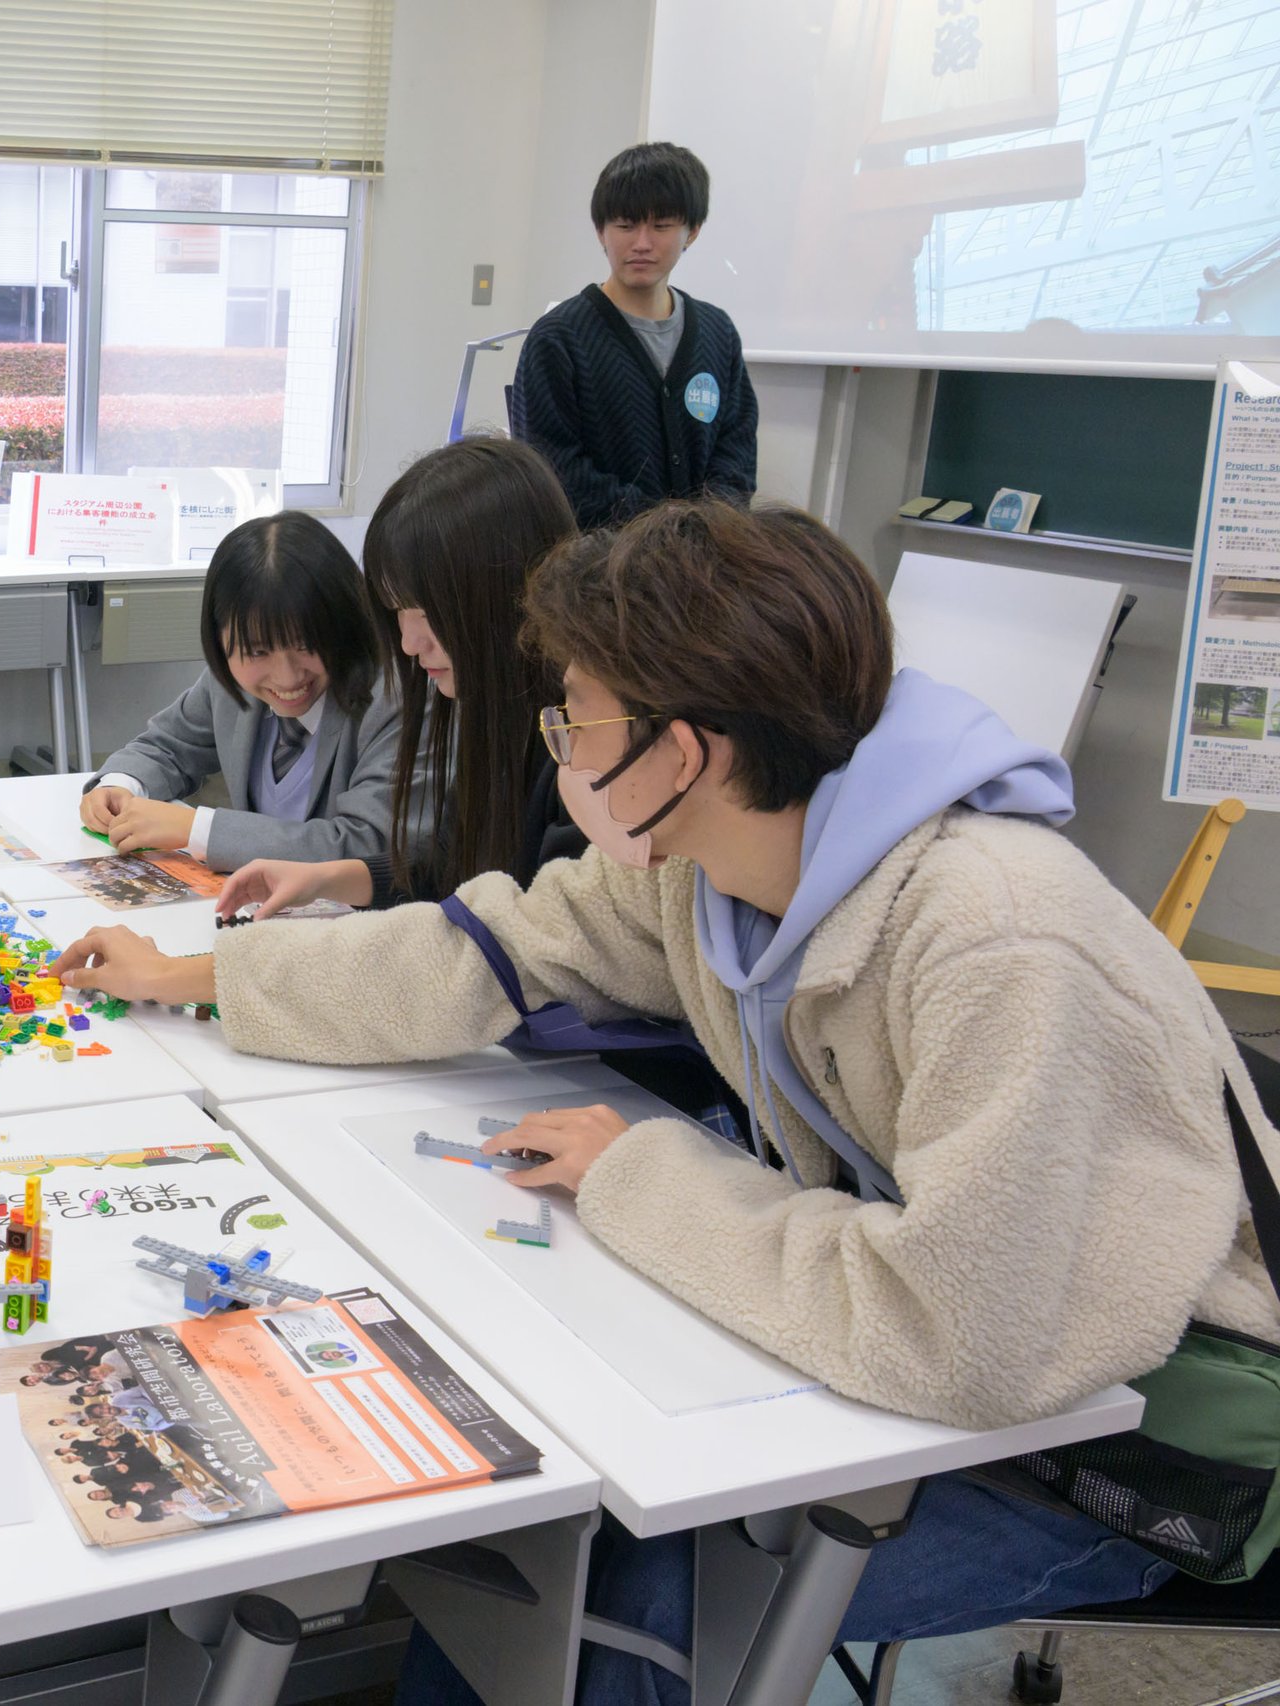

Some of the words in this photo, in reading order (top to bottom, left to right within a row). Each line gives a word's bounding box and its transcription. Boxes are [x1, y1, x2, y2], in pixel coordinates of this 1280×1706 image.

[1246, 474, 1277, 482] Purpose
[1214, 742, 1249, 751] Prospect
[111, 1332, 192, 1421] 都市空間研究会
[149, 1328, 233, 1424] Laboratory
[215, 1428, 267, 1469] Aqil
[1136, 1529, 1212, 1560] GREGORY
